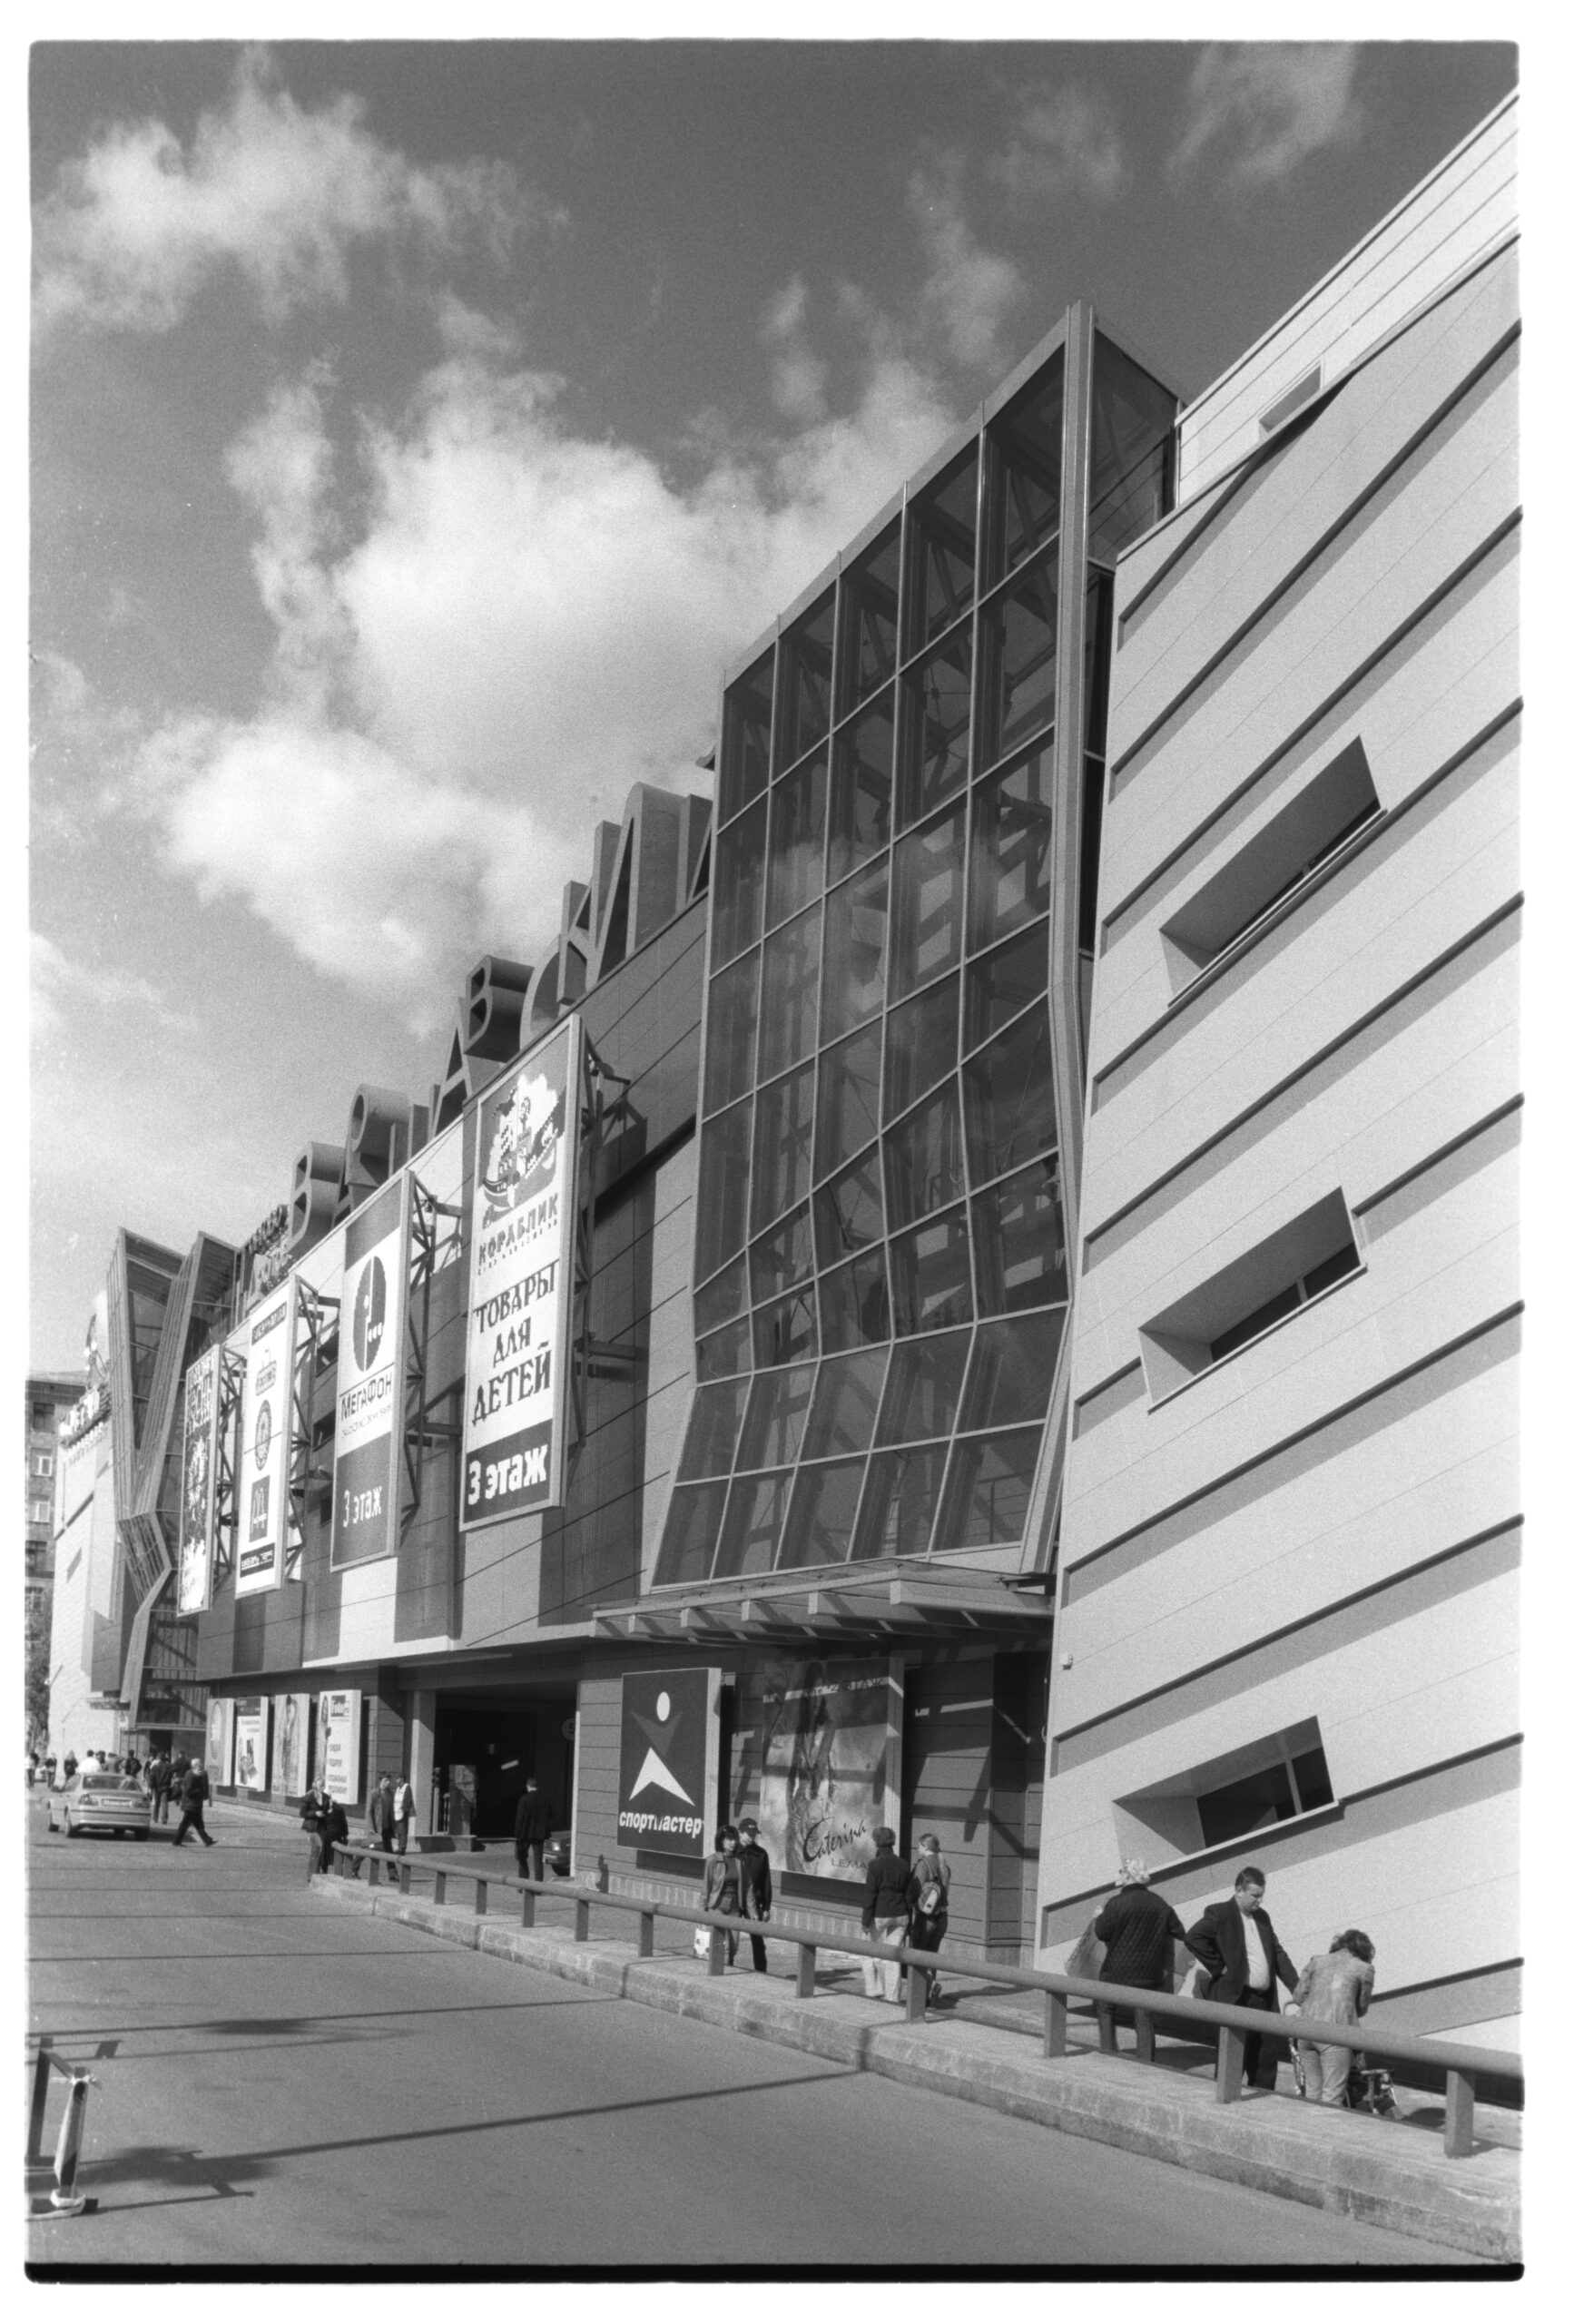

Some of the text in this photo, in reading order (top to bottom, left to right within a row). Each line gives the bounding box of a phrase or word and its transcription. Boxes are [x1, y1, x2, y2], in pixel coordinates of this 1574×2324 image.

[478, 1192, 558, 1266] КОРАБЛИК
[473, 1260, 556, 1334] ТОВАРЫ
[492, 1316, 532, 1368] ДЛЯ
[472, 1340, 552, 1427] ДЕТЕЙ
[467, 1443, 549, 1505] 3 этаж
[342, 1483, 383, 1528] 3 этаж
[619, 1811, 703, 1838] спортмастер
[803, 1816, 866, 1863] Caterina
[831, 1857, 869, 1869] LEMA
